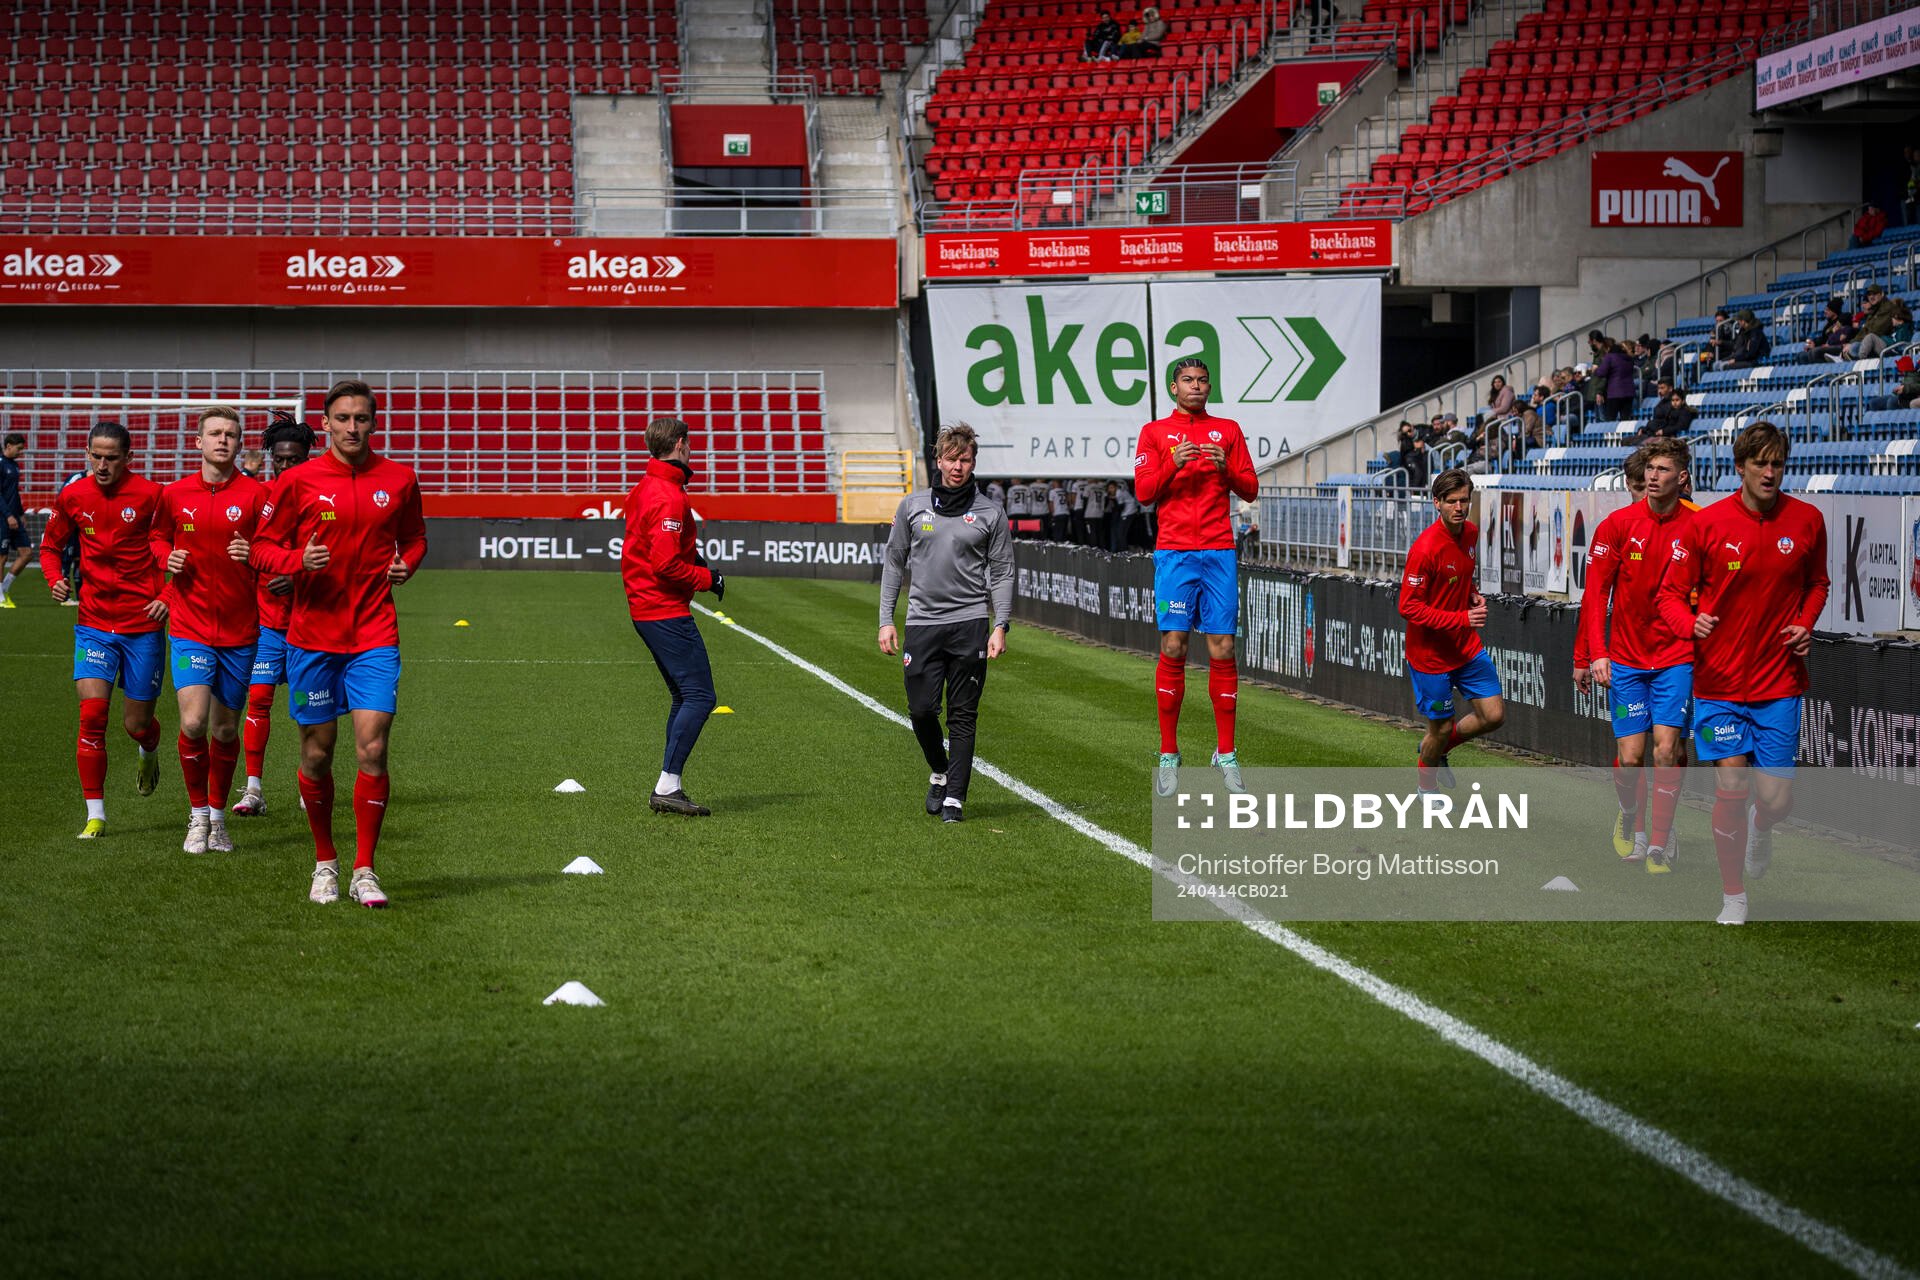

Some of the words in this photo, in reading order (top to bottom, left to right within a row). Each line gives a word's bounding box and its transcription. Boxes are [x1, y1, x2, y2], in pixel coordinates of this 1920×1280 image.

[1600, 190, 1700, 224] PUMA
[1028, 242, 1090, 258] backhaus
[1120, 238, 1183, 256] backhaus
[1214, 236, 1279, 252] backhaus
[1310, 233, 1376, 250] backhaus
[940, 244, 999, 260] backhaus
[3, 248, 85, 276] akea
[286, 248, 368, 278] akea
[568, 250, 649, 278] akea
[964, 295, 1223, 406] akea
[1030, 436, 1096, 459] PART
[1105, 434, 1136, 458] OF
[320, 512, 336, 520] XXL
[183, 523, 196, 532] XXL
[1503, 504, 1516, 550] HK
[480, 536, 582, 560] HOTELL
[1630, 552, 1642, 560] XXL
[1870, 543, 1898, 566] KAPITAL
[1845, 514, 1865, 622] K
[1869, 577, 1900, 600] GRUPPEN
[1170, 600, 1186, 609] Solid
[1246, 576, 1302, 678] SUPERETTAN
[87, 648, 105, 659] Solid
[1325, 618, 1354, 667] HOTELL
[1360, 624, 1376, 672] SPA
[1382, 628, 1406, 677] GOLF
[190, 655, 208, 664] Solid
[308, 688, 330, 700] Solid
[1628, 702, 1645, 712] Solid
[1714, 724, 1736, 736] Solid
